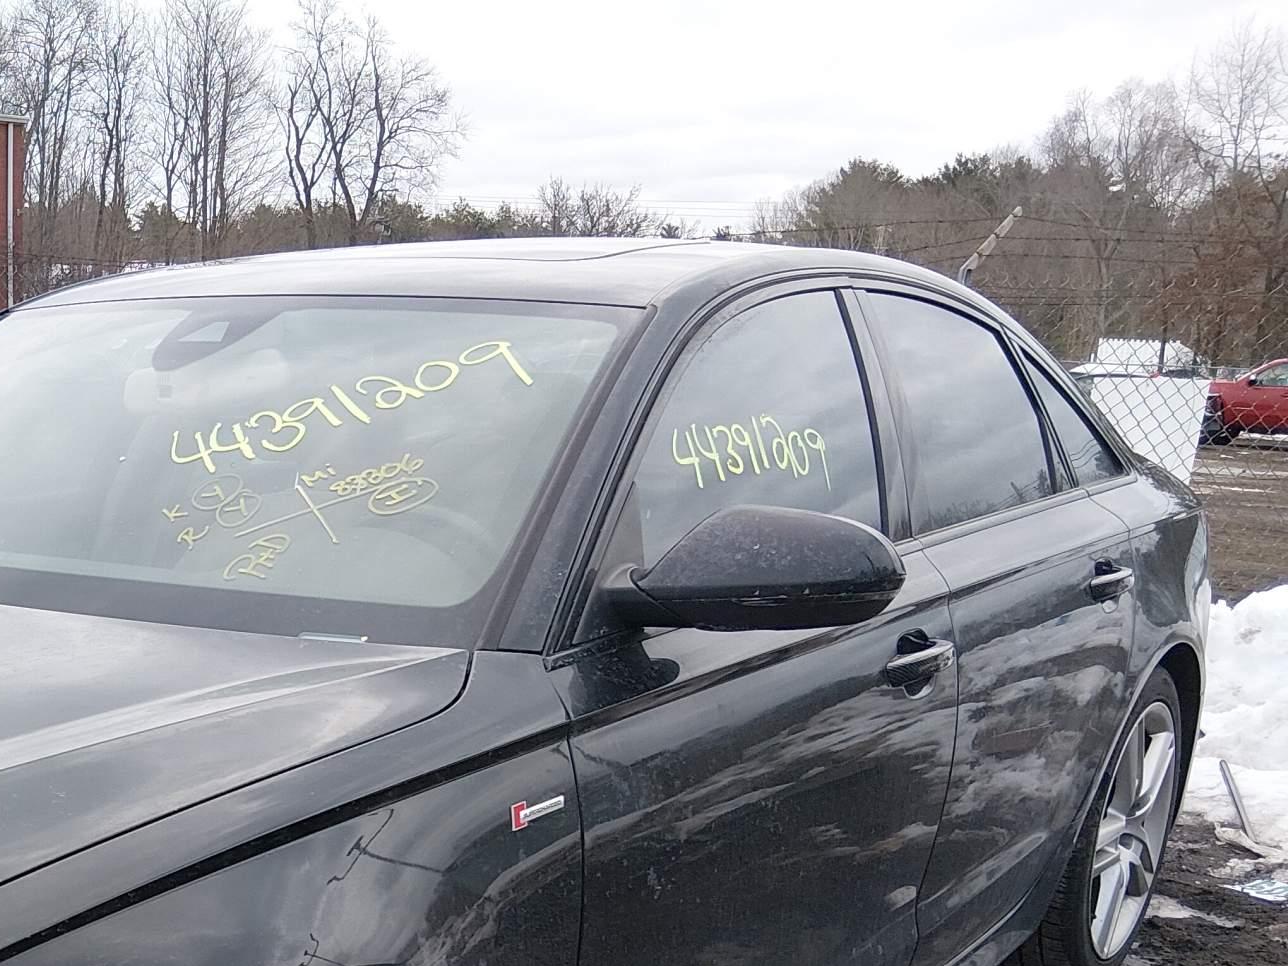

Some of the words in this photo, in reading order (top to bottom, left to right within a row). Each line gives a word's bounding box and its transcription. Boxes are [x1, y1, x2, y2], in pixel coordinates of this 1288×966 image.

[171, 341, 534, 474] 44391209
[672, 413, 831, 492] 44391209
[162, 504, 189, 522] K
